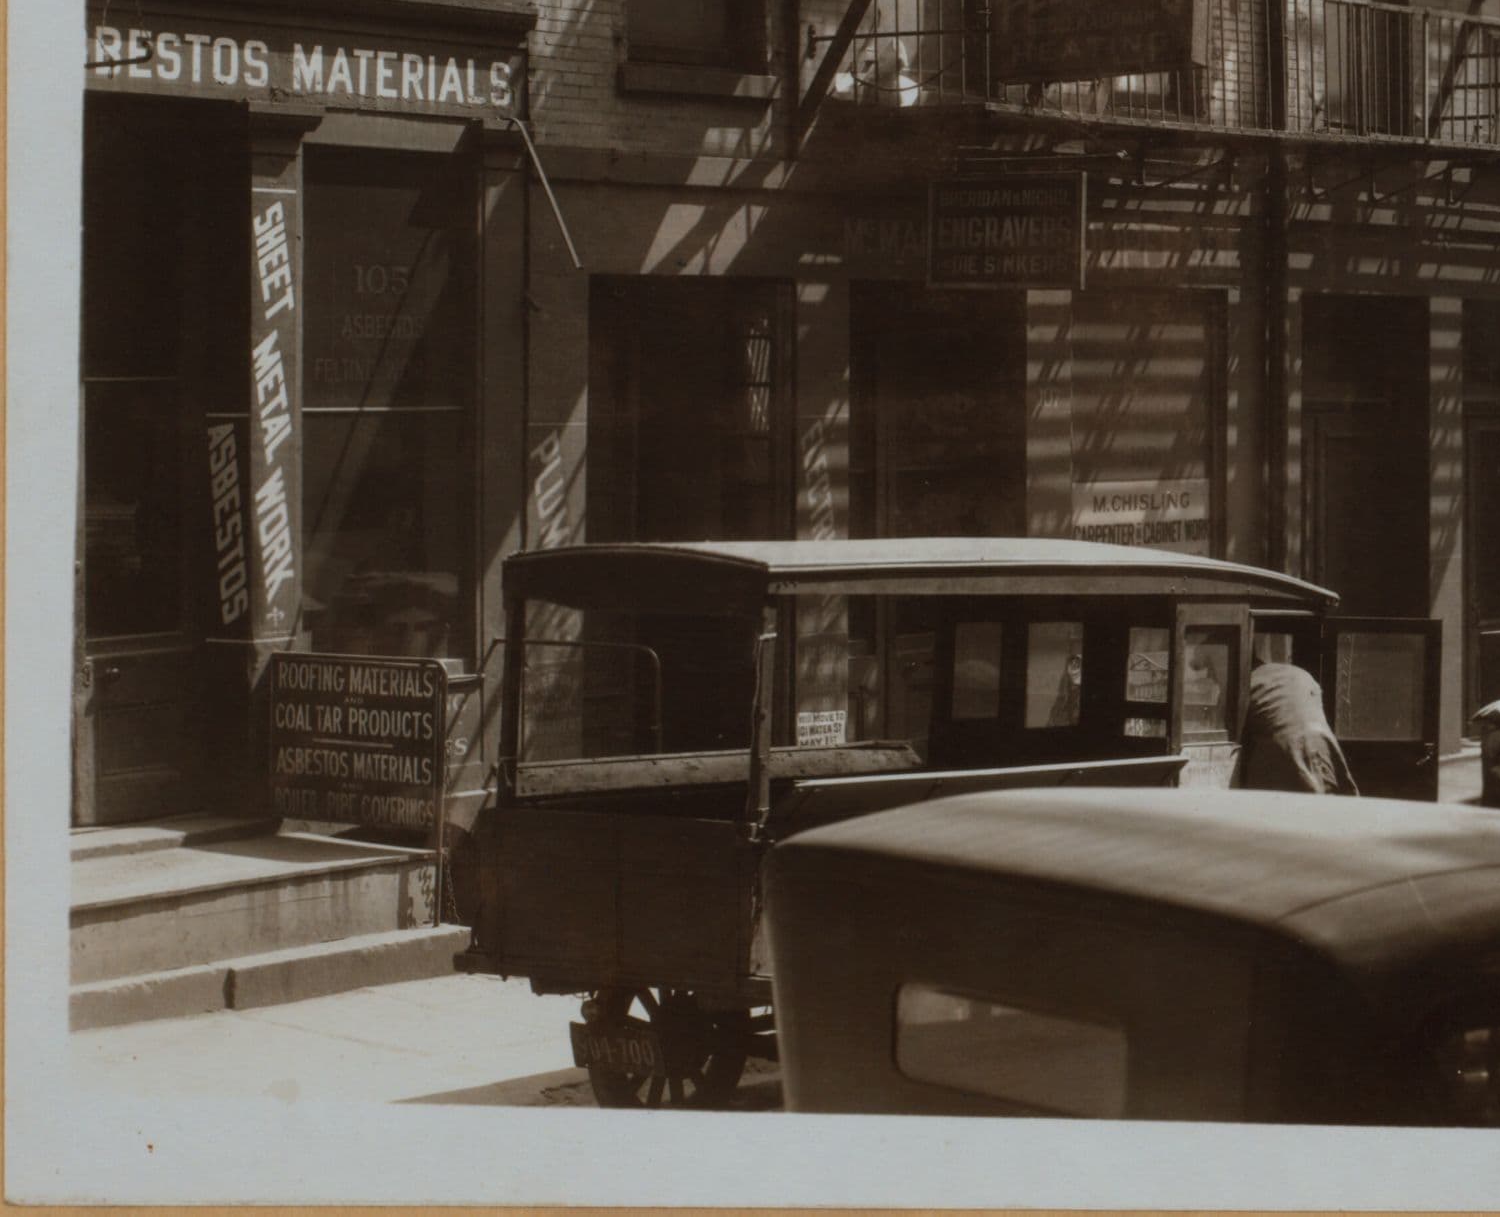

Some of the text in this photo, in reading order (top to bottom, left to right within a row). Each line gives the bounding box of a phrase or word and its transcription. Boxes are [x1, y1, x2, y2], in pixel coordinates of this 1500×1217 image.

[293, 42, 512, 106] MATERIALS
[938, 214, 1072, 249] ENGRAVERS
[252, 201, 295, 320] SHEET
[353, 263, 409, 295] 105
[252, 329, 293, 466] METAL
[207, 422, 249, 625] ASBESTOS
[254, 466, 295, 604] WORK
[278, 661, 434, 698] ROOFING MATERIALS
[343, 696, 364, 705] AND
[275, 703, 433, 740] COAL TAR PRODUCTS
[275, 747, 432, 785] ASBESTOS MATERIALS
[361, 794, 434, 826] COVERINGS
